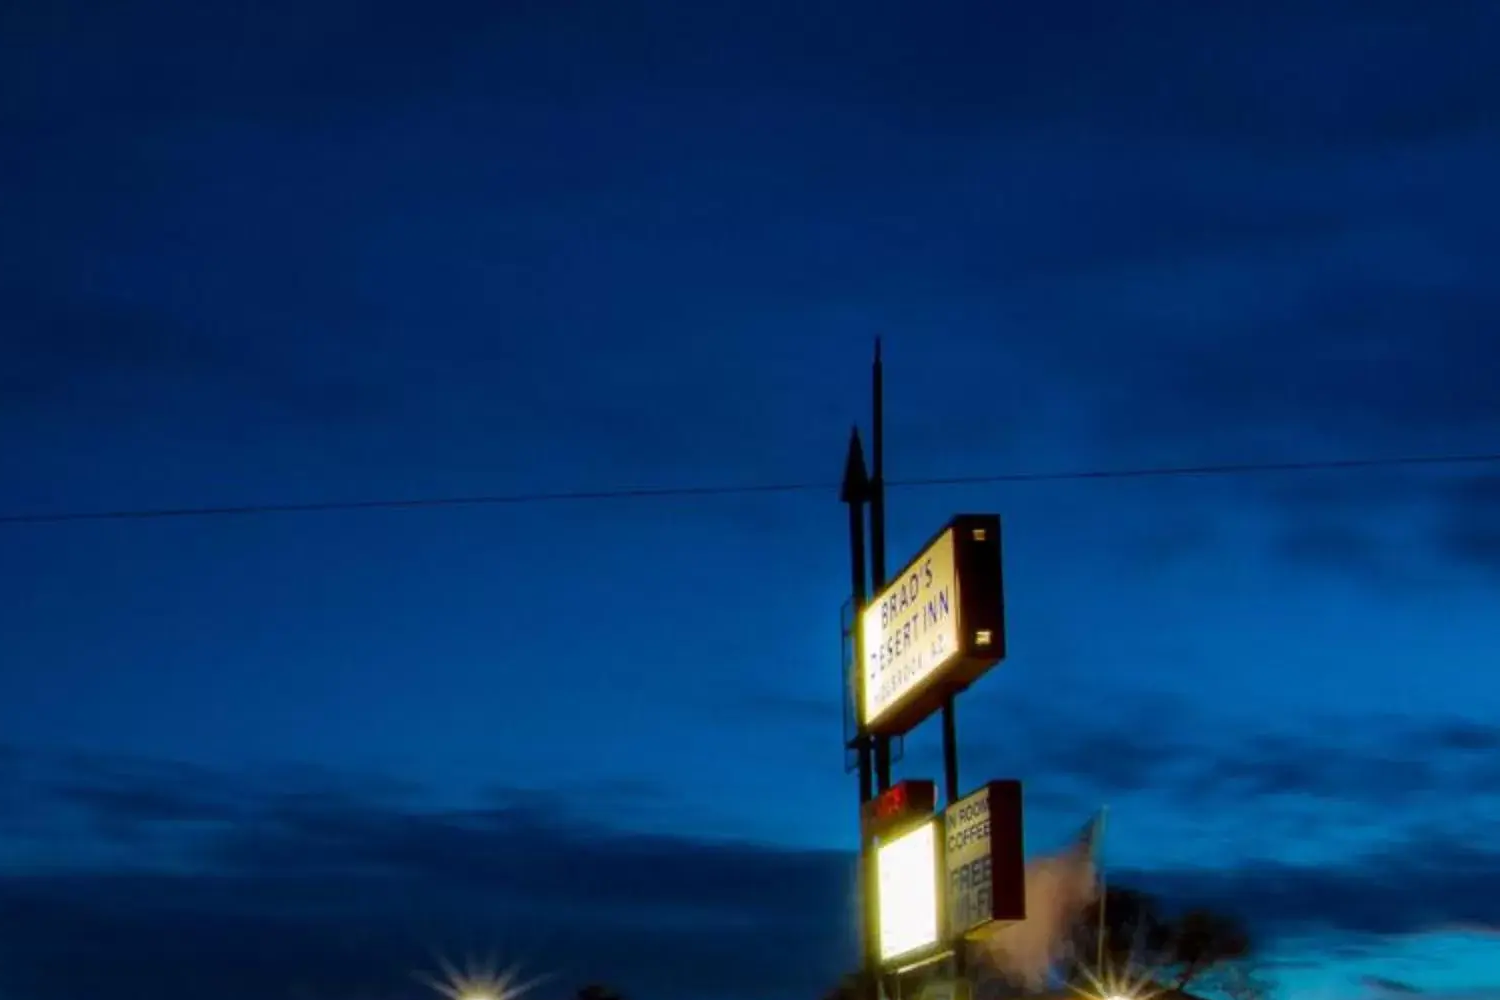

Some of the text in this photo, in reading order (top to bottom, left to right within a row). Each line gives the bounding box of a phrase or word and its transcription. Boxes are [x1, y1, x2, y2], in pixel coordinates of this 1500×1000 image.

[881, 556, 933, 630] BRAD'S
[922, 583, 949, 633] INN
[949, 818, 989, 853] COFFEE
[951, 854, 991, 896] FREE
